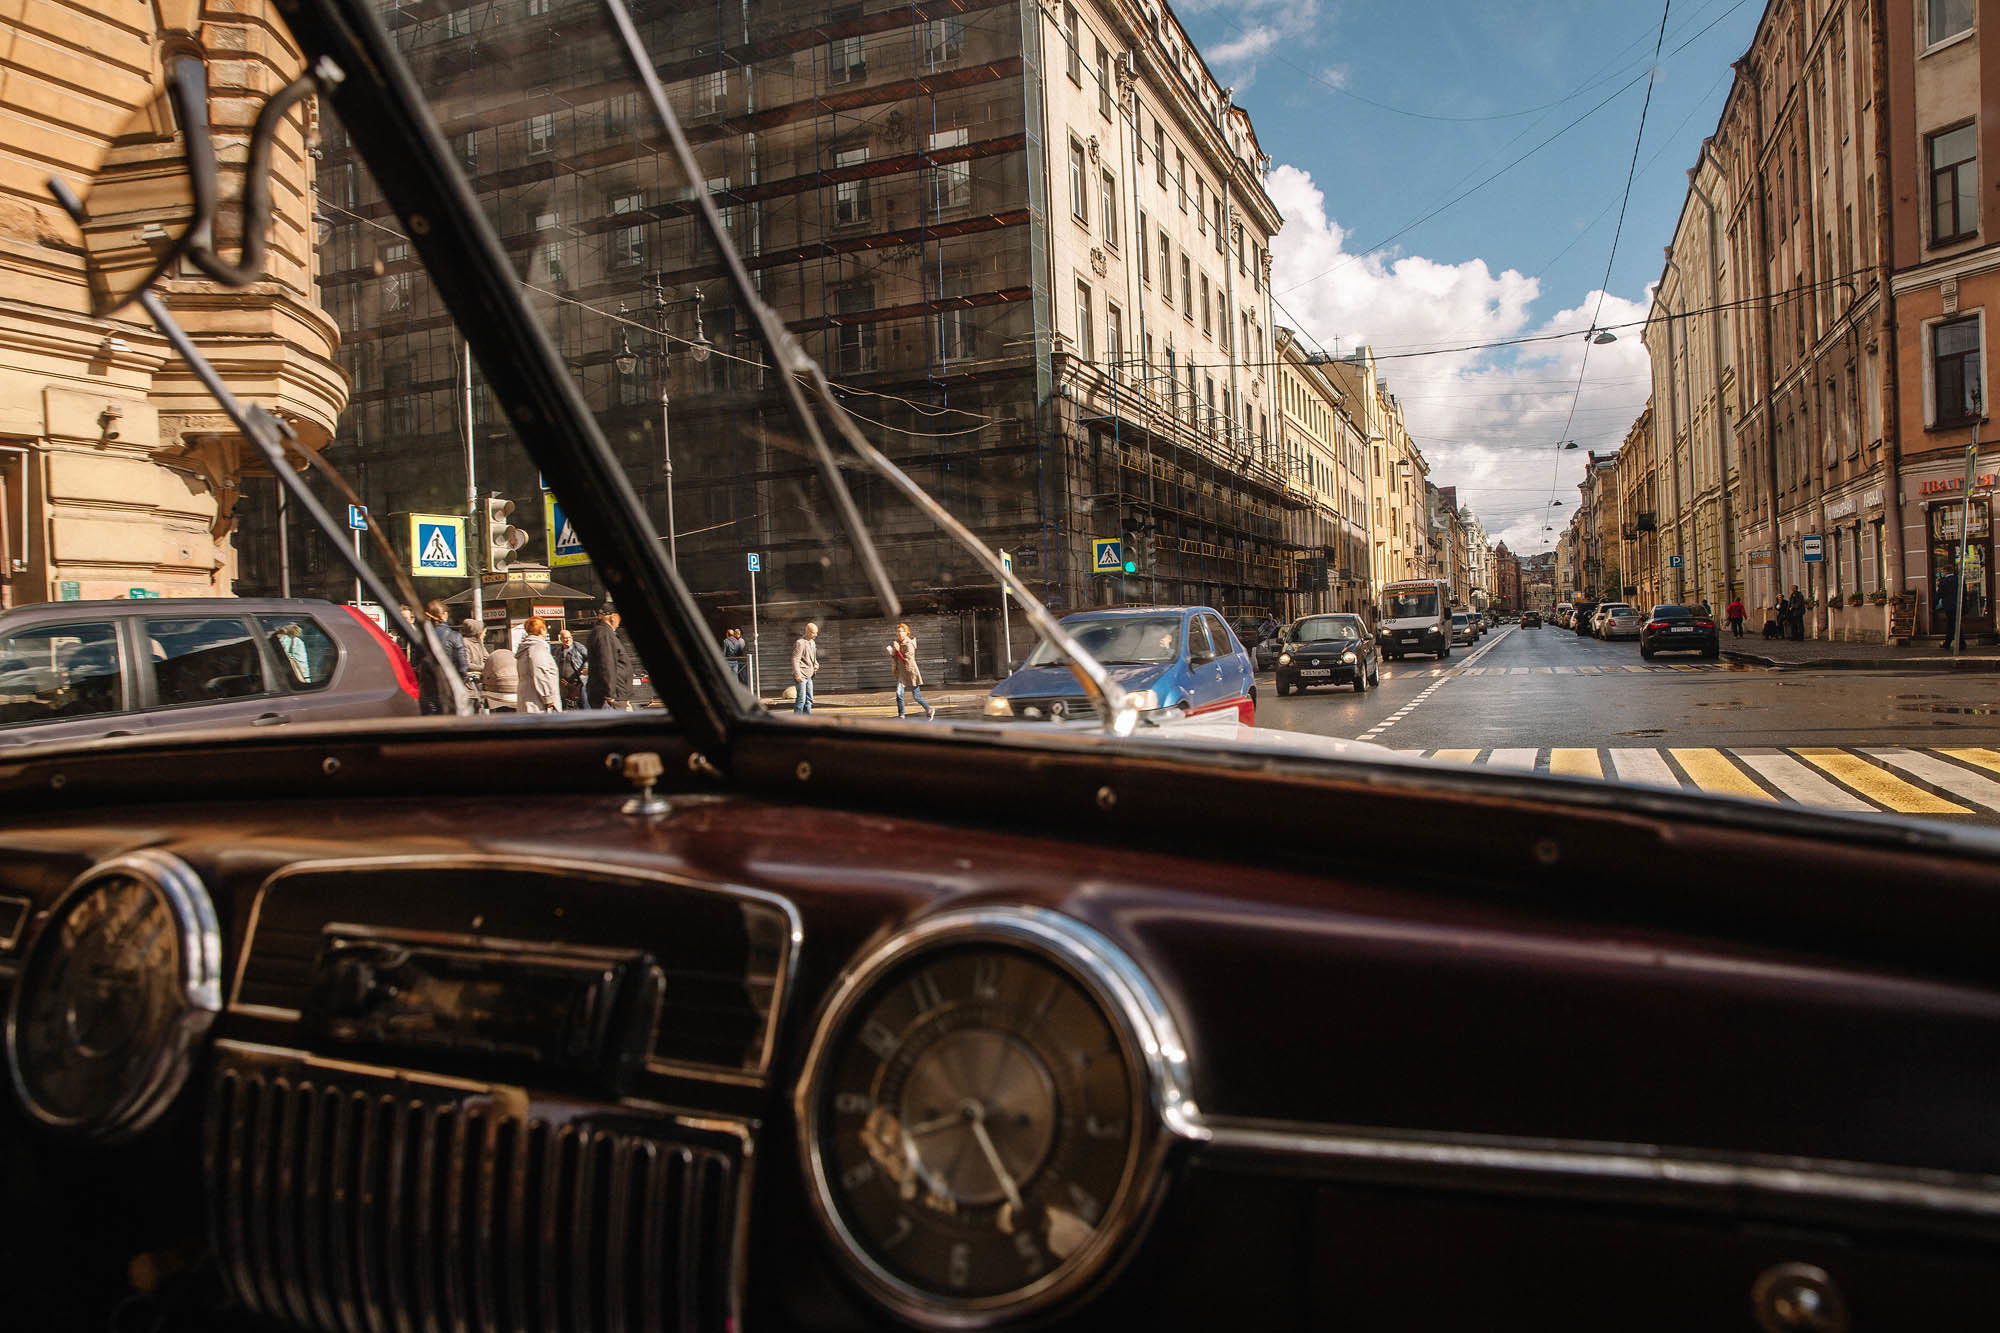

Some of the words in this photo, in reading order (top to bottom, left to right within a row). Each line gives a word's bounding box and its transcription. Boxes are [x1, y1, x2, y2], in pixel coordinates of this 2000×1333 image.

[1919, 479, 1949, 494] ДВА
[1953, 473, 1993, 489] ГСЯ
[1673, 556, 1681, 566] P
